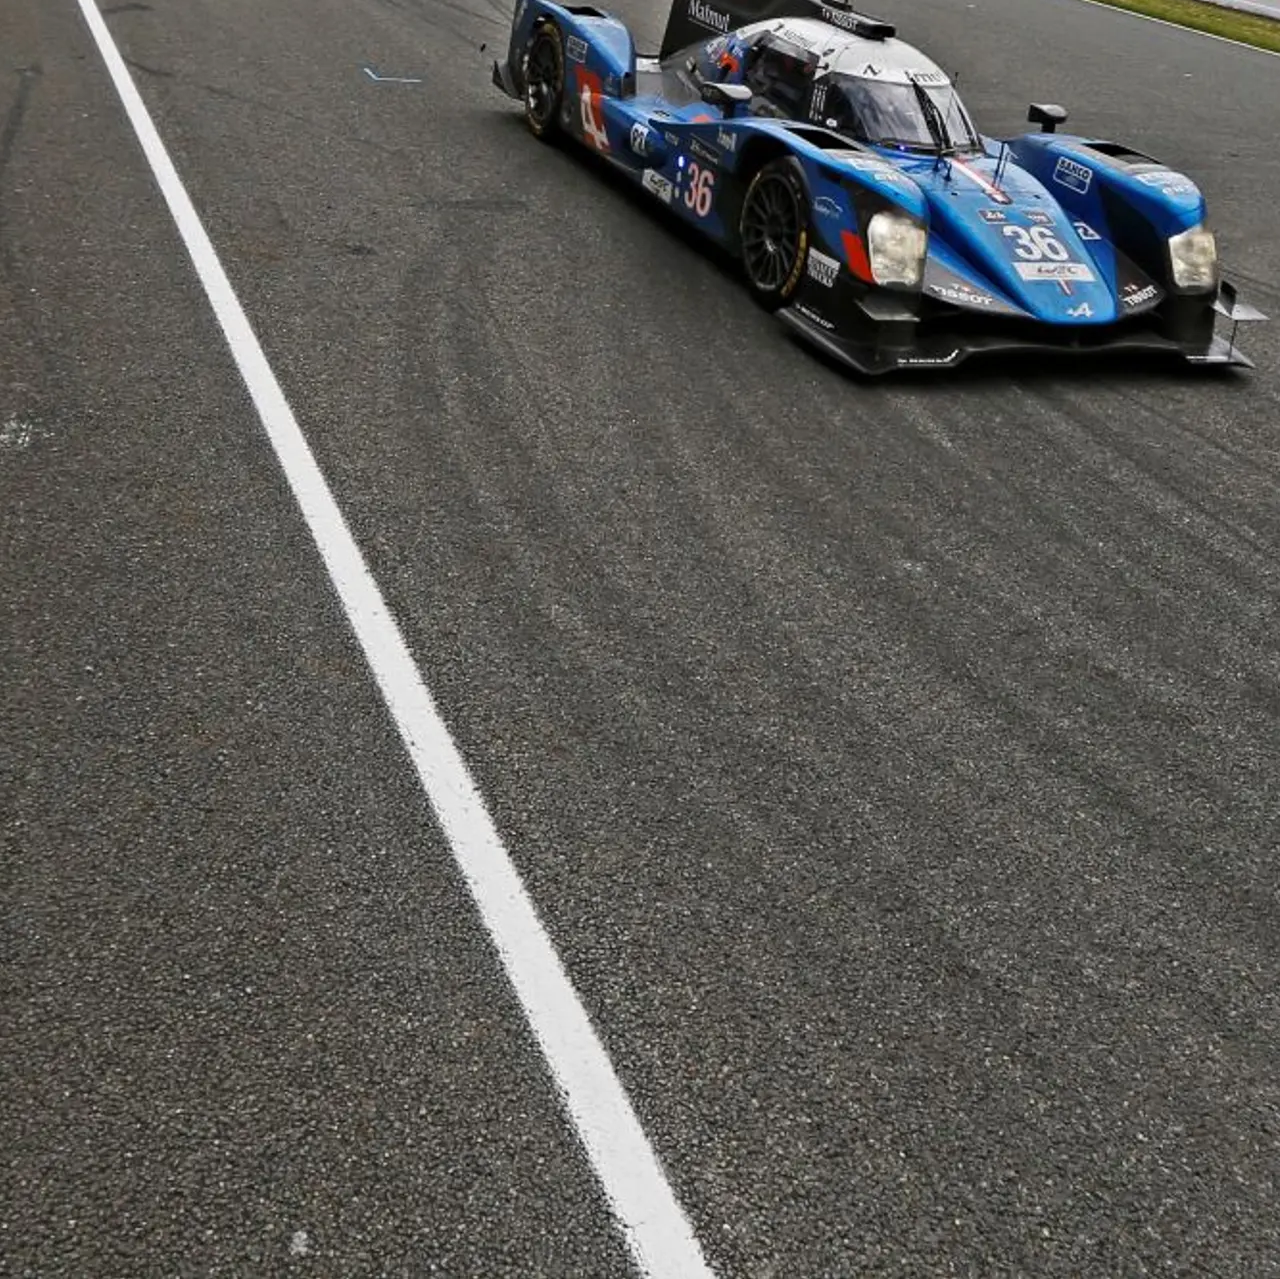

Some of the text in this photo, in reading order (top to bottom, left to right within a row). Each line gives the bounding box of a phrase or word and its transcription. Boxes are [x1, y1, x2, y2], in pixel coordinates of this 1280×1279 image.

[684, 162, 715, 217] 36
[1002, 224, 1069, 262] 36
[1123, 284, 1158, 306] TISSOT
